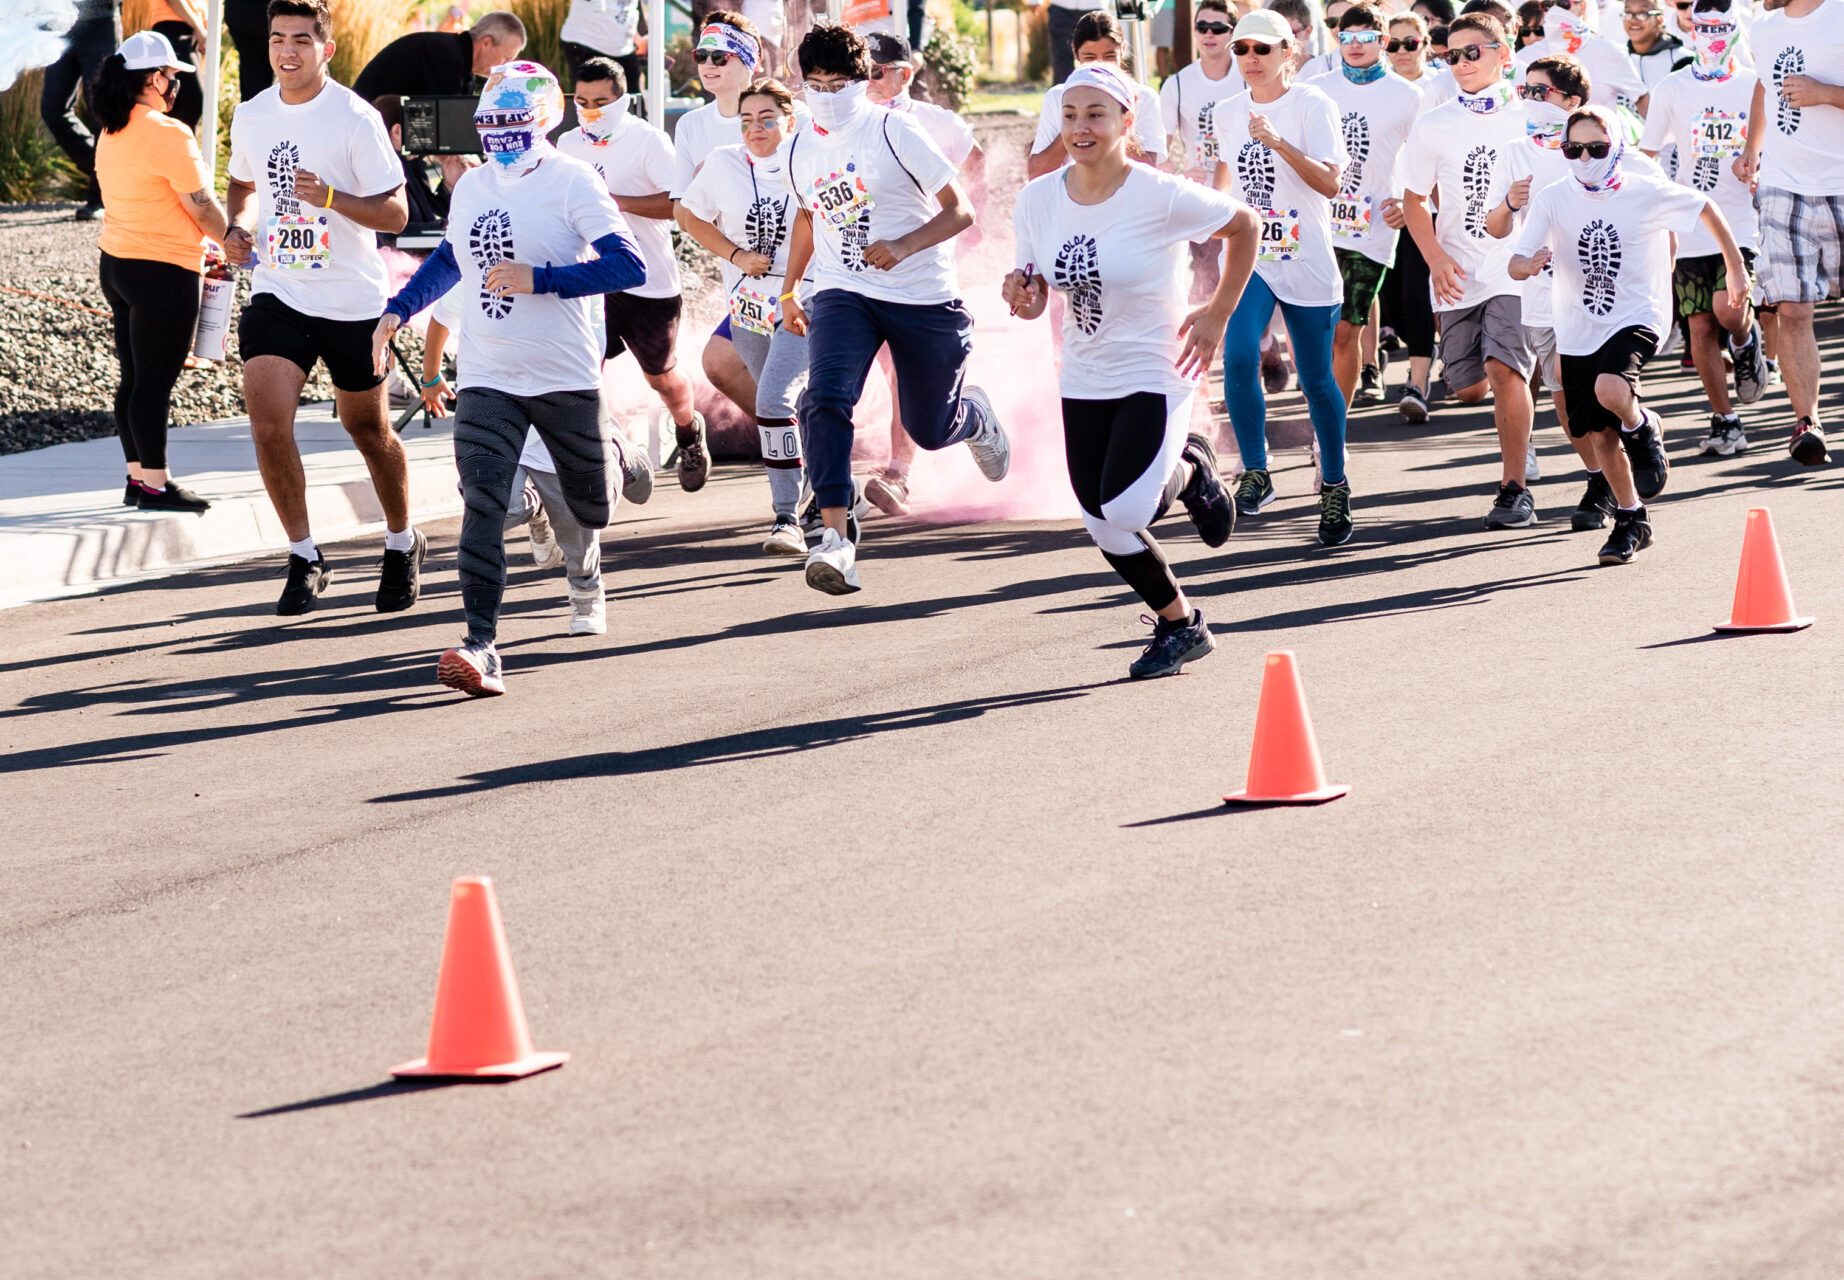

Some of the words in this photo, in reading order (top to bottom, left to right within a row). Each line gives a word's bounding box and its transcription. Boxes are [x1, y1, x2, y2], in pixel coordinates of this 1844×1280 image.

[1705, 123, 1733, 140] 412
[269, 140, 290, 162] COLOR
[289, 144, 300, 164] RUN
[1204, 142, 1219, 158] 35
[1465, 145, 1486, 166] COLOR
[1487, 149, 1497, 162] RU
[280, 157, 290, 166] 5K
[818, 181, 854, 211] 536
[473, 209, 500, 229] COLOR
[761, 211, 772, 220] 5K
[1331, 202, 1357, 221] 184
[279, 228, 314, 249] 280
[485, 224, 498, 233] 5K
[1261, 221, 1283, 241] 26
[1580, 219, 1603, 242] COLOR
[1604, 223, 1620, 243] RUN
[1058, 234, 1086, 260] COLOR
[1085, 238, 1098, 259] RUN
[1593, 237, 1606, 246] 5K
[1071, 253, 1085, 264] 5K
[739, 298, 762, 321] 257
